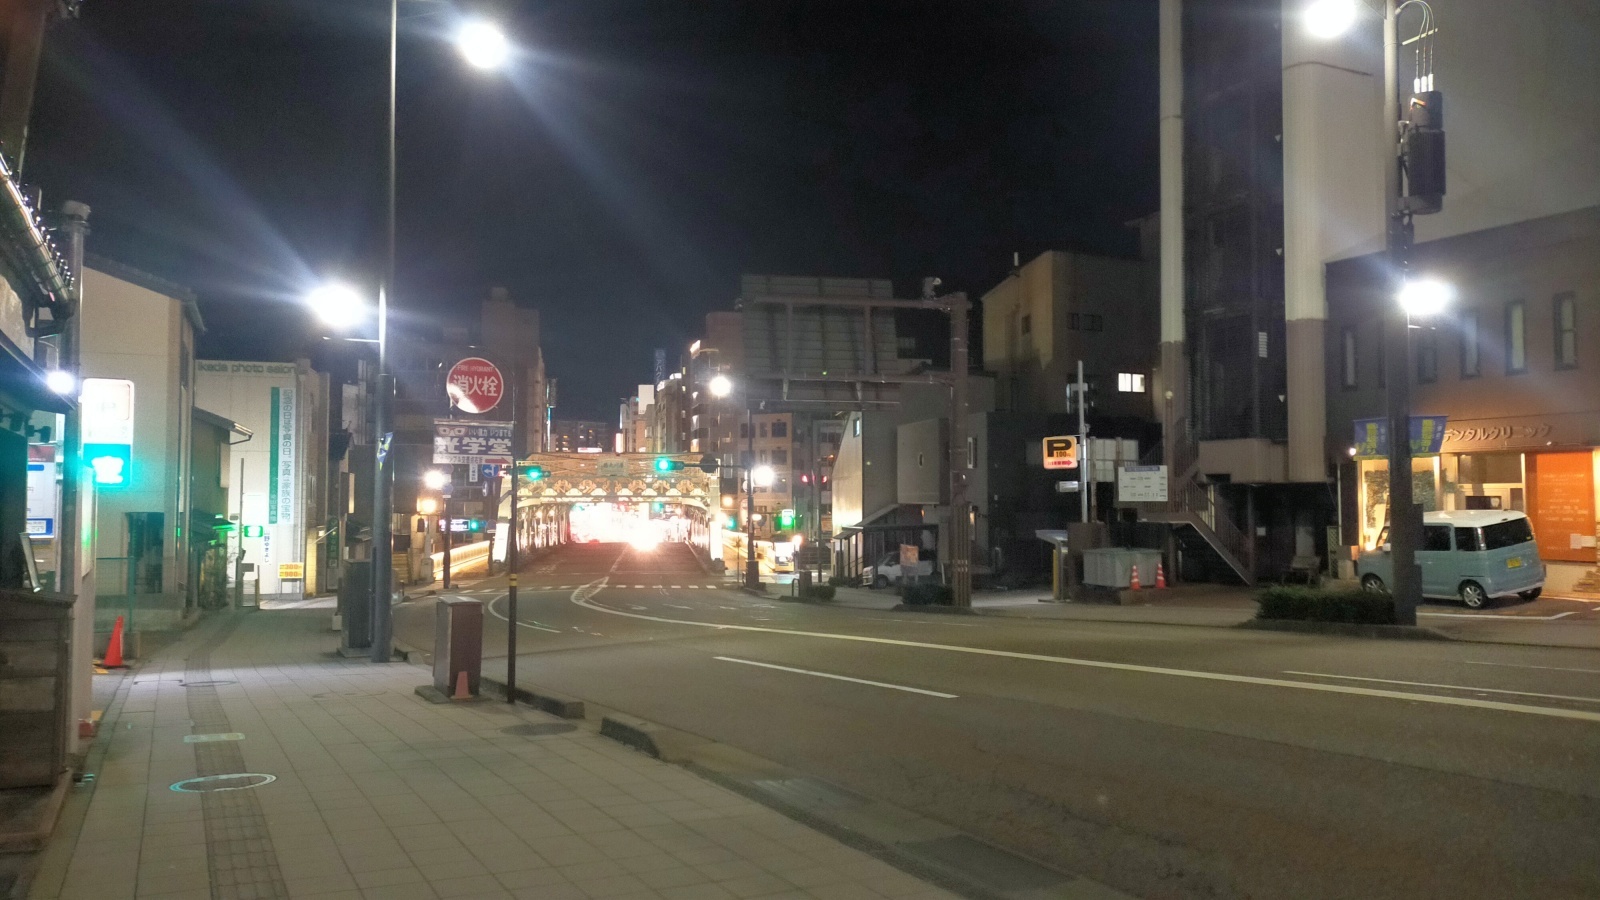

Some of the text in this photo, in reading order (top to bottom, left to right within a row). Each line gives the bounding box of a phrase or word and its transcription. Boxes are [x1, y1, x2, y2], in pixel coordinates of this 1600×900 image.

[453, 374, 499, 396] 消火栓
[434, 437, 512, 454] 光学堂
[1047, 439, 1072, 457] P
